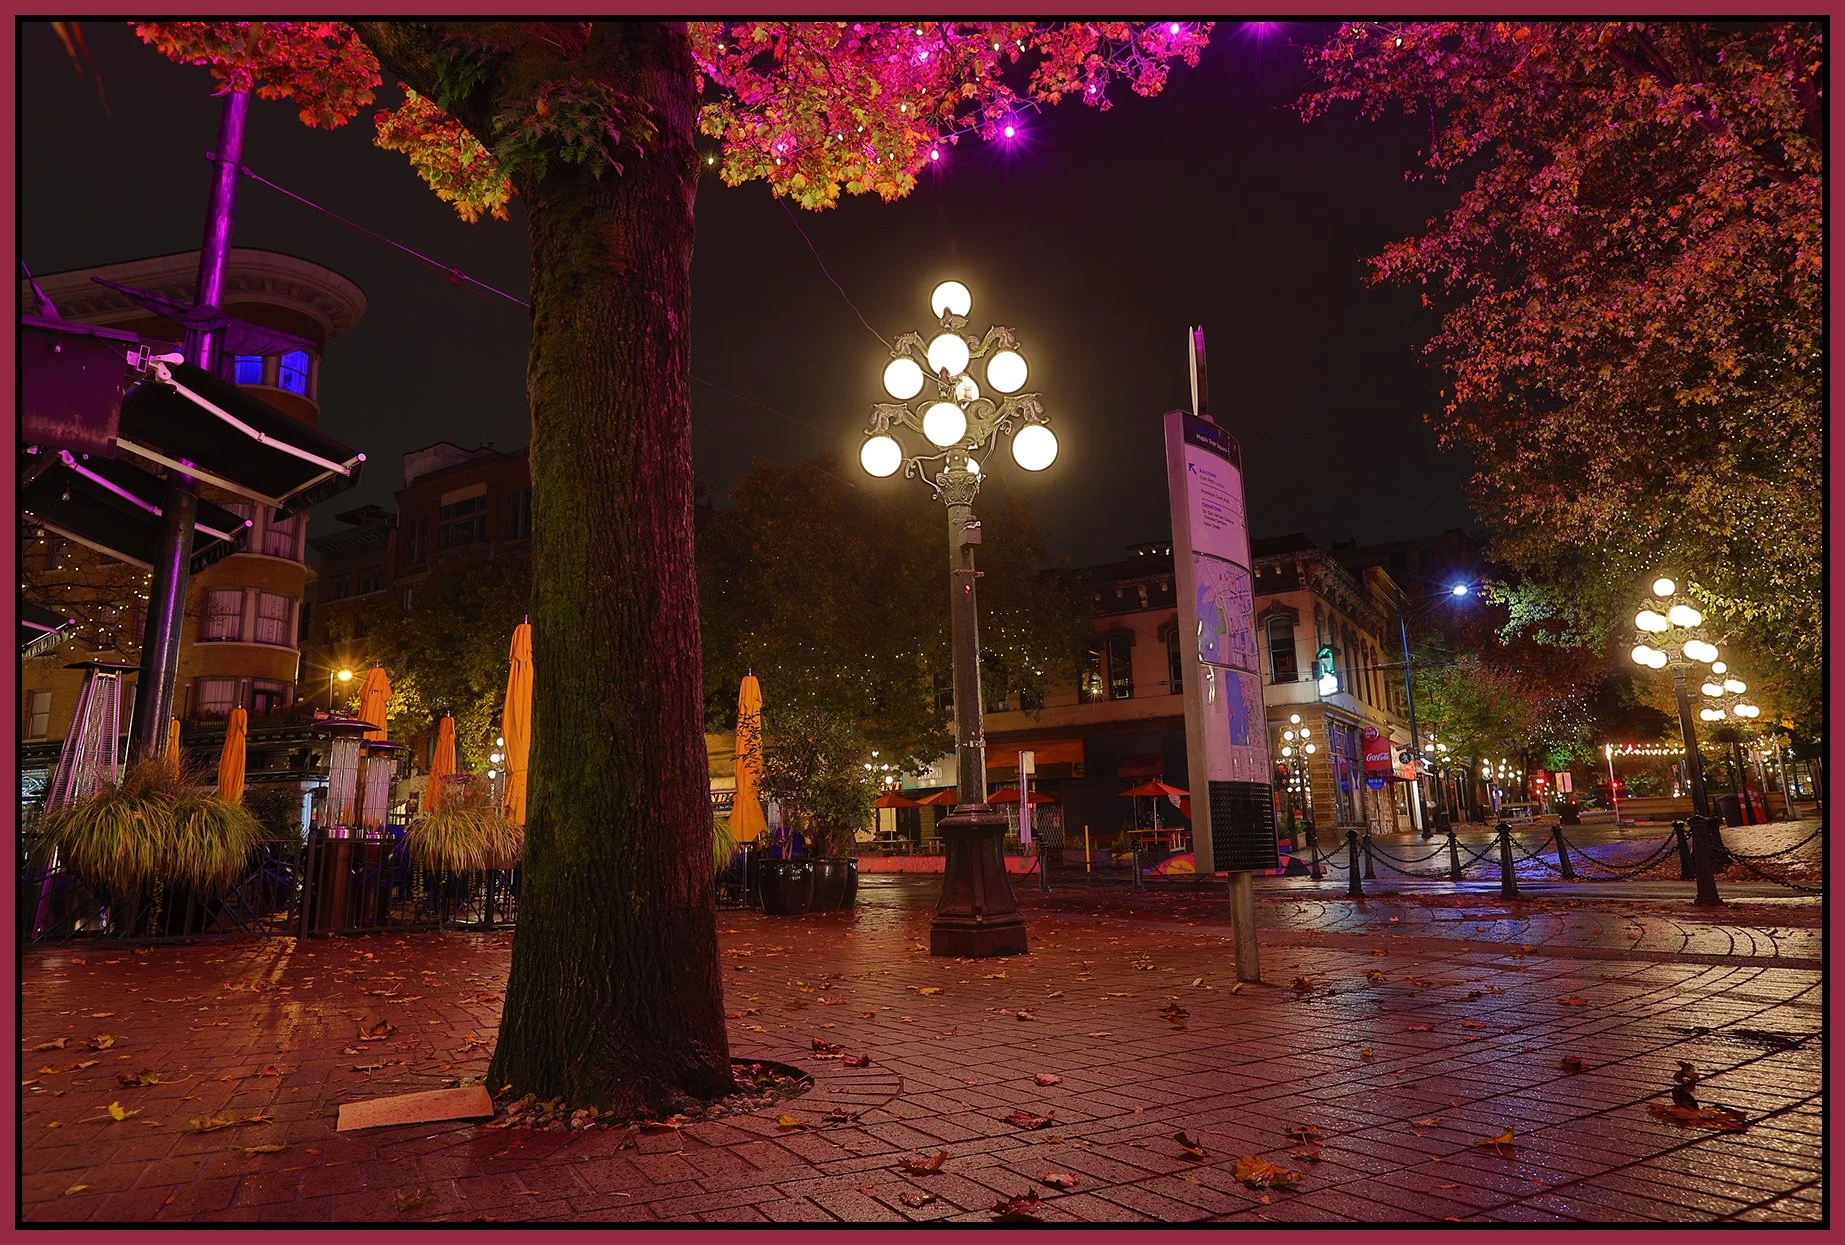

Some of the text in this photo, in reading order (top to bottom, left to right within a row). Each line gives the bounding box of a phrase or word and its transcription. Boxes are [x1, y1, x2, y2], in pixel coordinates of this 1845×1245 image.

[1196, 433, 1208, 443] Maple
[1217, 442, 1228, 453] Square
[1366, 752, 1390, 762] Coca-Cola
